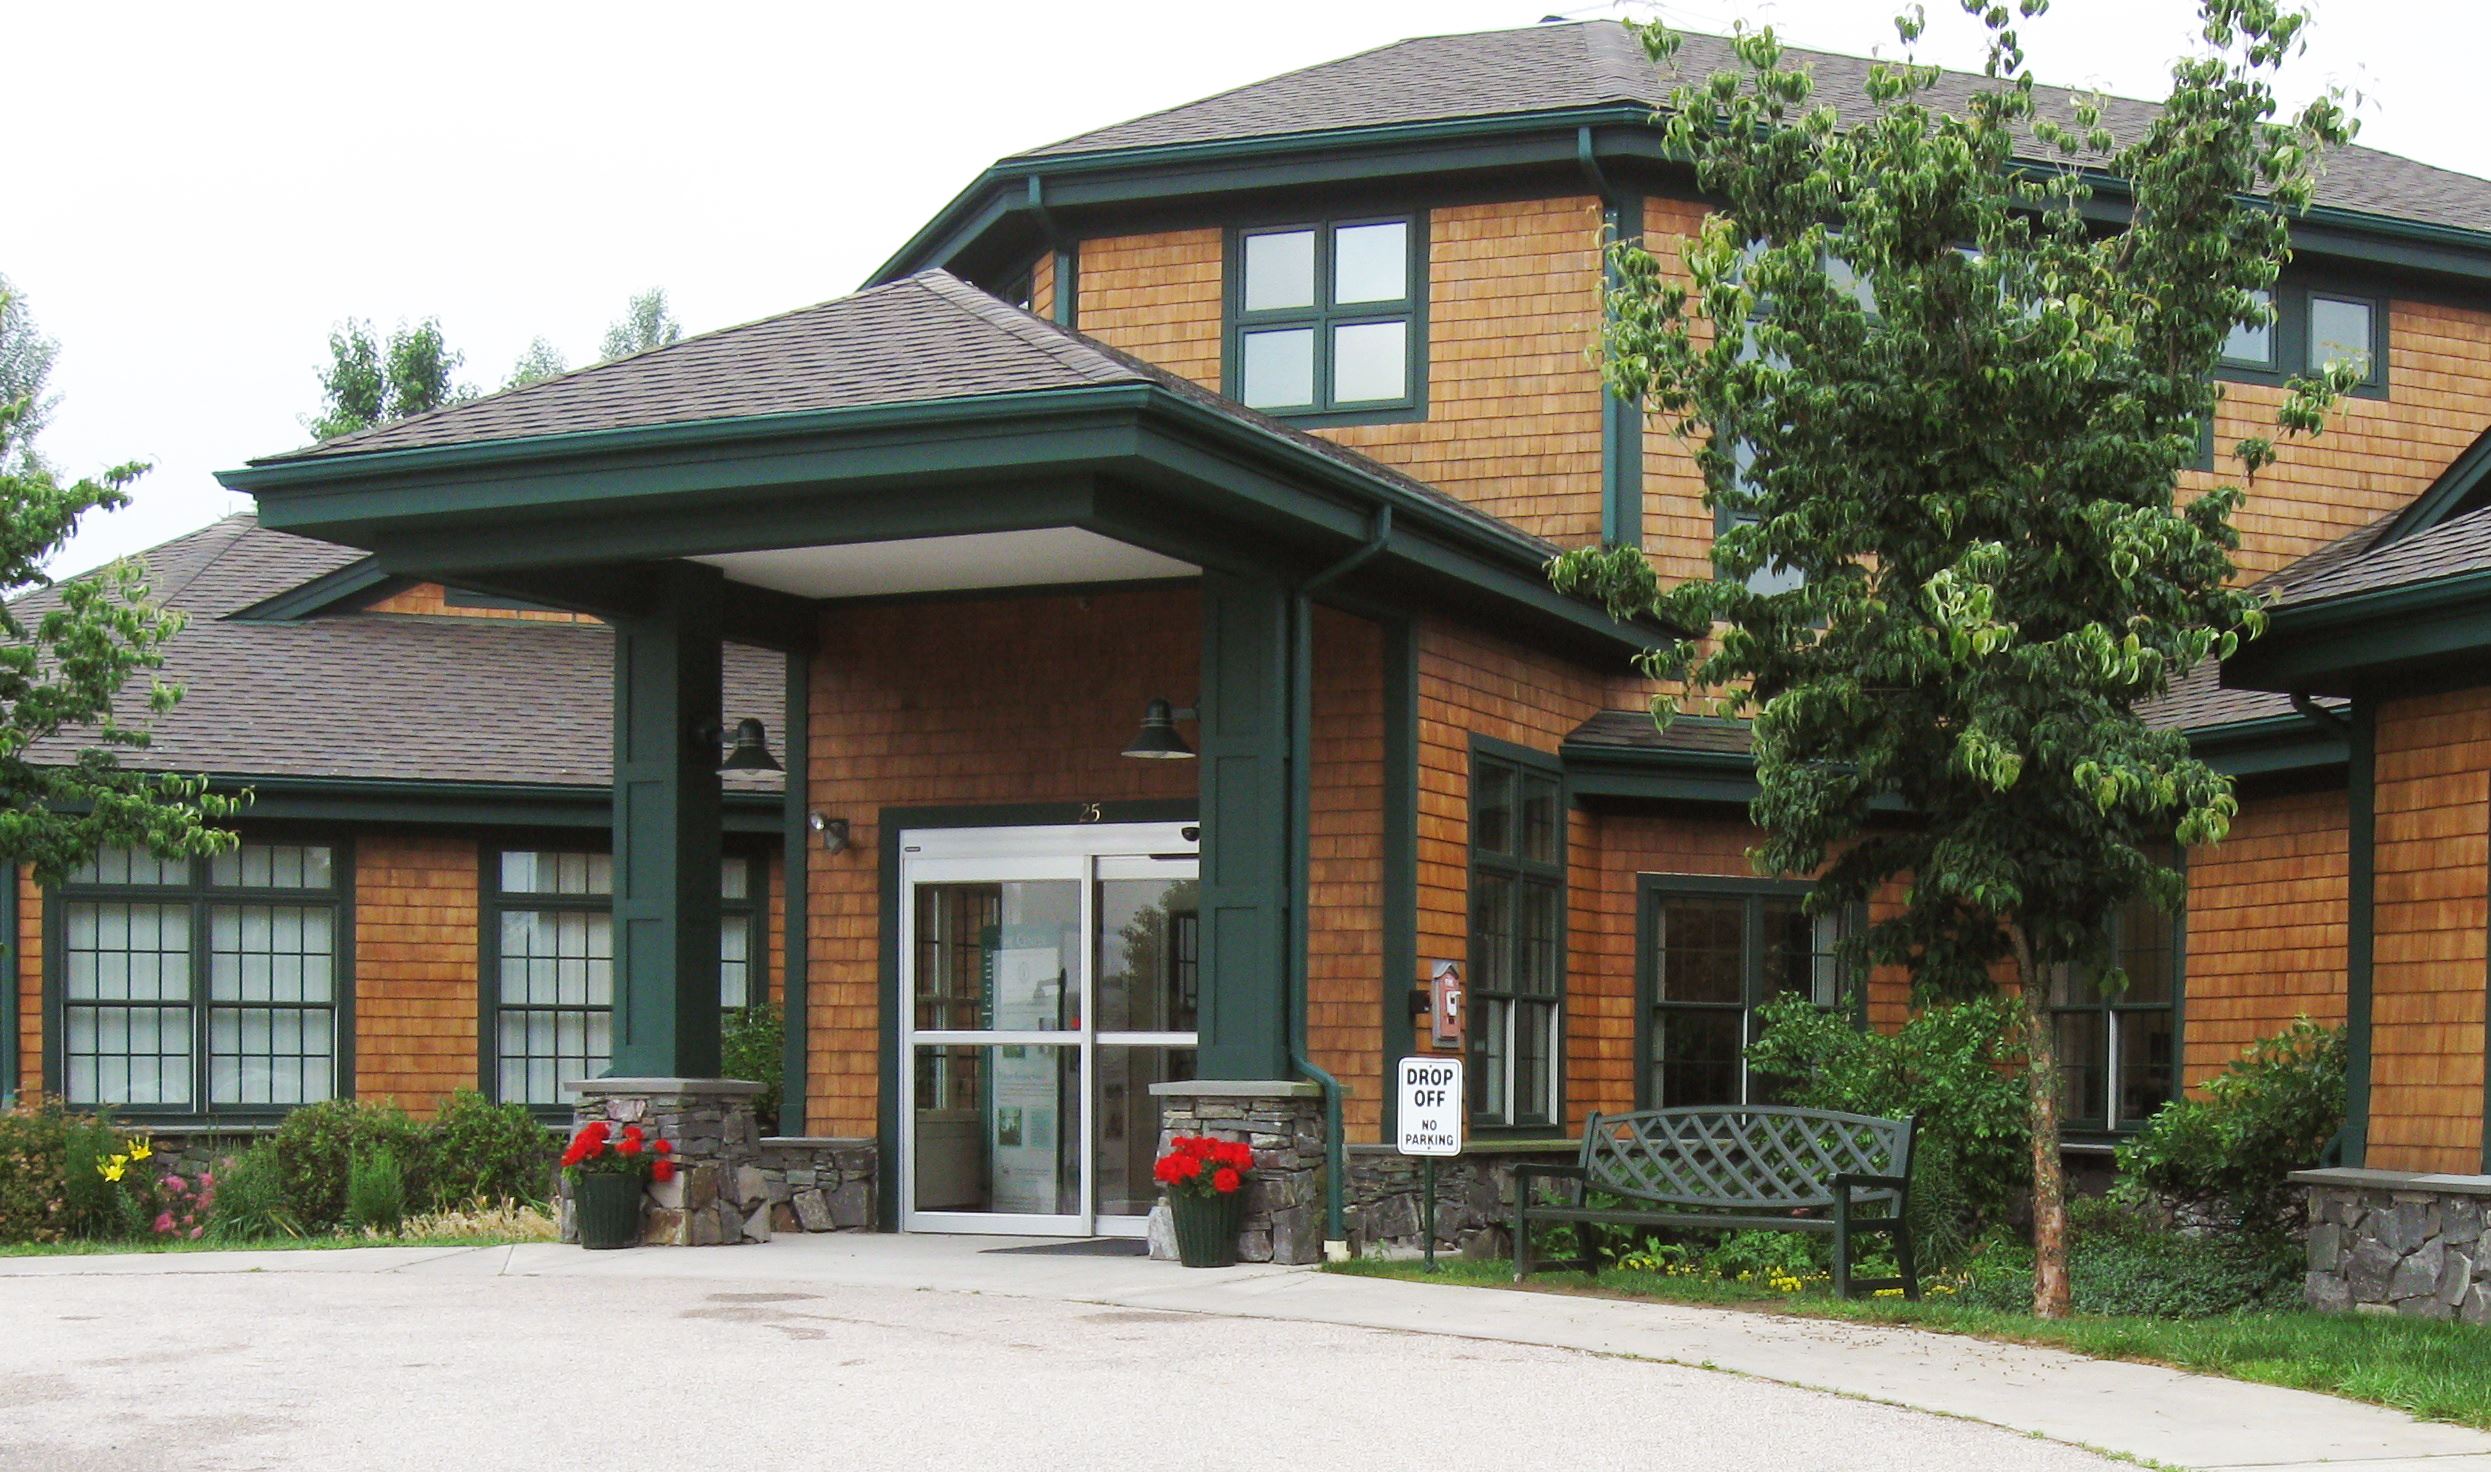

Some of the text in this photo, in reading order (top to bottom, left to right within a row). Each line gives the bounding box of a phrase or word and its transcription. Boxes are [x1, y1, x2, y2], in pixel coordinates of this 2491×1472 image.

[1079, 803, 1101, 822] 25
[981, 948, 992, 1030] elcome
[1407, 1069, 1453, 1085] DROP
[1414, 1090, 1445, 1107] OFF
[1422, 1120, 1437, 1131] NO
[1405, 1134, 1454, 1146] PARKING
